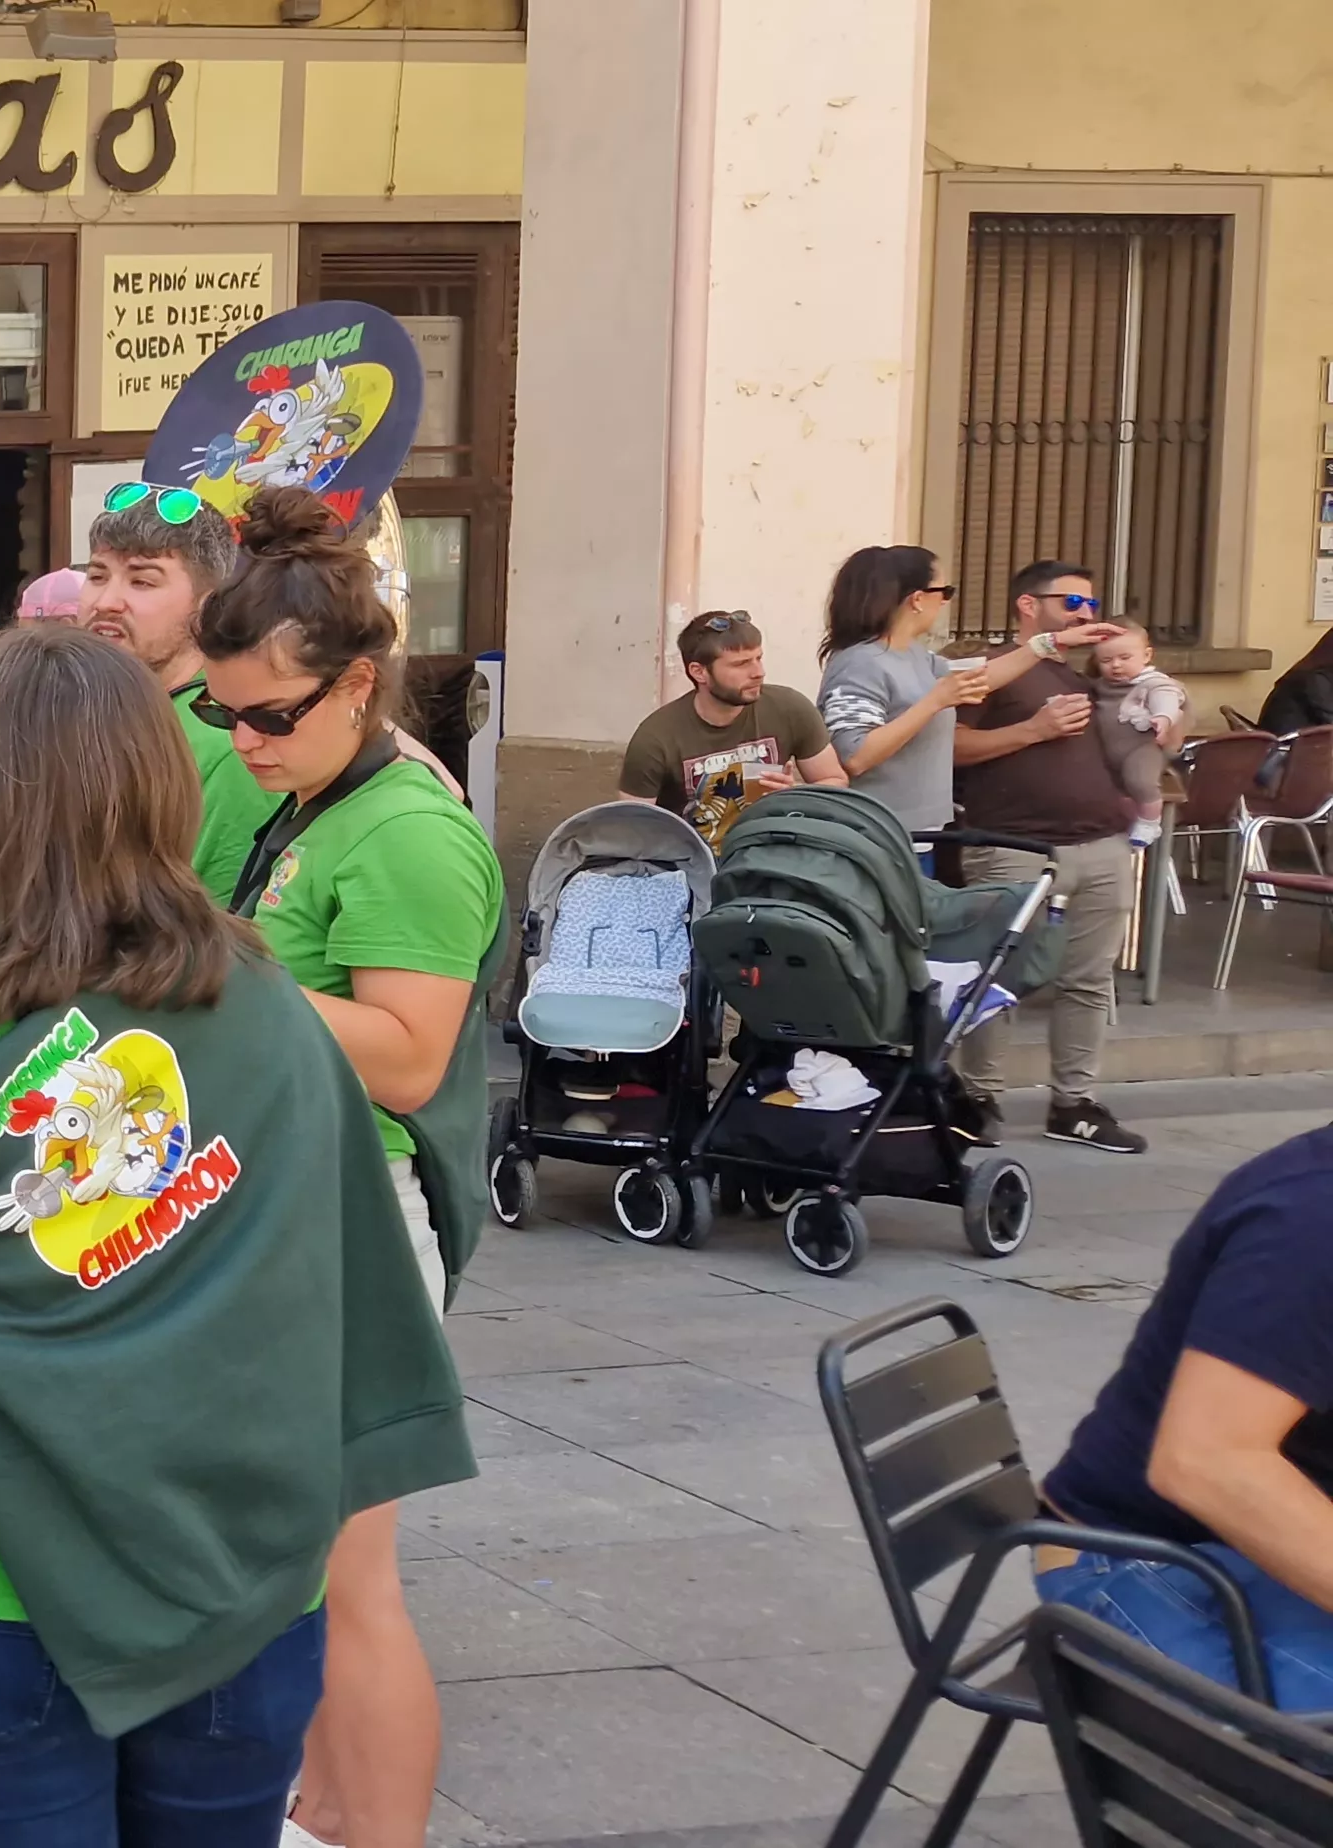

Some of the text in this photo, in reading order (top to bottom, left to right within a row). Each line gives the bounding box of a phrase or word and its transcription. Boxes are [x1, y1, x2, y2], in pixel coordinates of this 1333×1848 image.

[113, 263, 263, 294] ME PIDIÓ UN CAFÉ
[115, 305, 127, 327] Y
[137, 305, 155, 325] LE
[235, 322, 366, 383] CHARANGA
[78, 1140, 240, 1288] CHILINDRON
